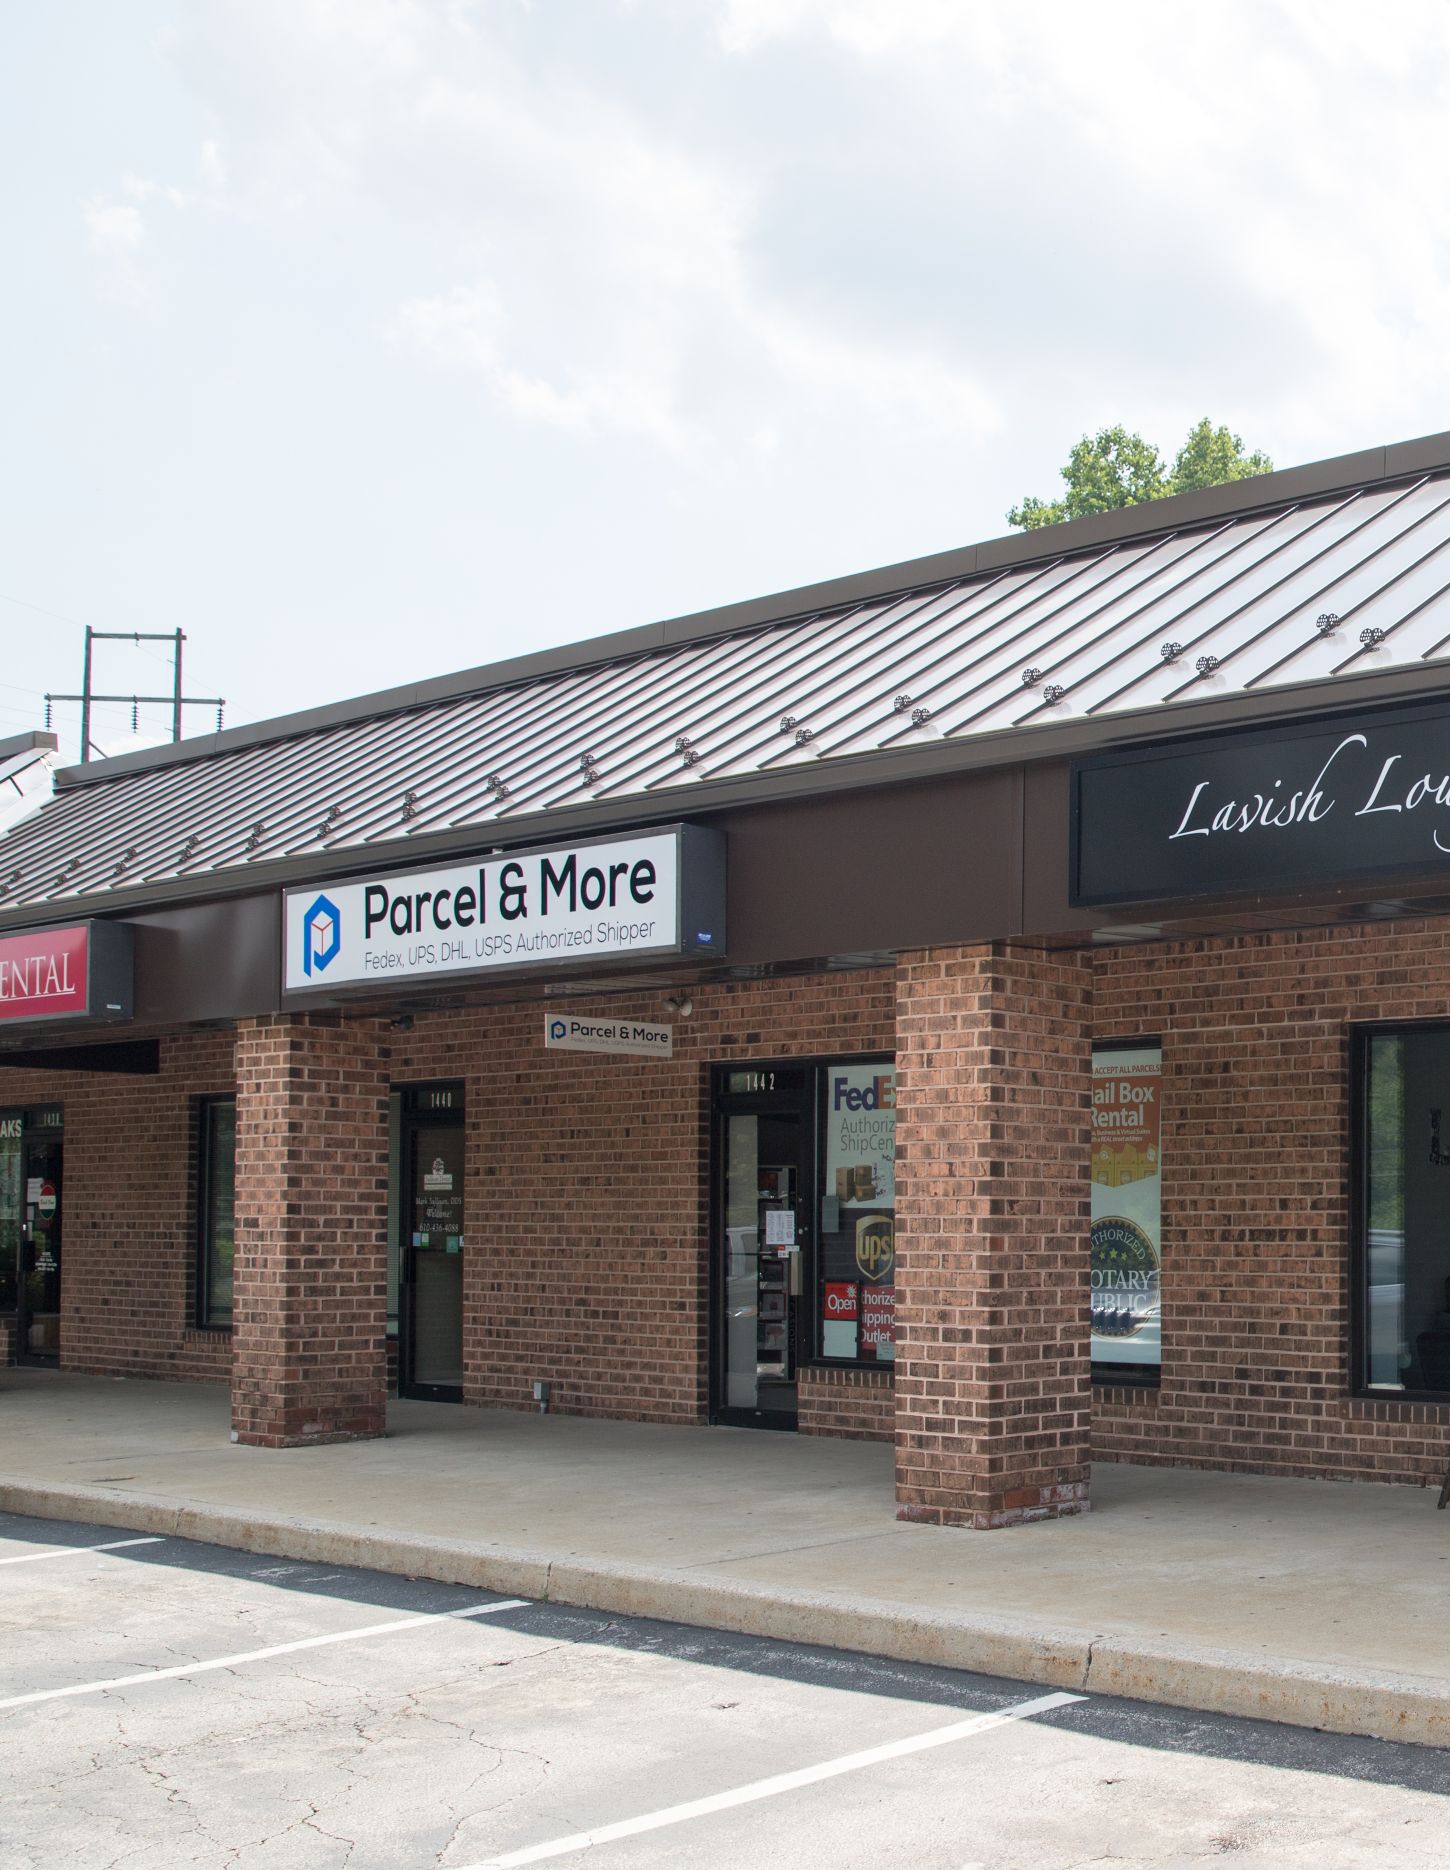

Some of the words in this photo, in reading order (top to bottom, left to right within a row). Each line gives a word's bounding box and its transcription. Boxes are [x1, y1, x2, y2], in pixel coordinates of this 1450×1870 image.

[1169, 734, 1367, 840] Lavish
[364, 868, 486, 939] Parcel
[499, 862, 527, 920] &
[540, 853, 656, 916] More
[364, 949, 405, 970] Fedex,
[408, 945, 438, 965] UPS,
[441, 942, 471, 961] DHL,
[475, 934, 512, 957] USPS
[516, 923, 592, 952] Authorized
[597, 920, 656, 949] Shipper
[0, 952, 76, 999] ENTAL
[570, 1022, 616, 1038] Parcel
[619, 1026, 629, 1039] &
[633, 1028, 669, 1043] More
[1095, 1066, 1118, 1075] ACCEPT
[1119, 1065, 1131, 1073] ALL
[746, 1073, 775, 1091] 1442
[1120, 1082, 1155, 1104] Box
[862, 1235, 890, 1270] ups
[828, 1294, 856, 1313] Open
[863, 1290, 895, 1305] horize
